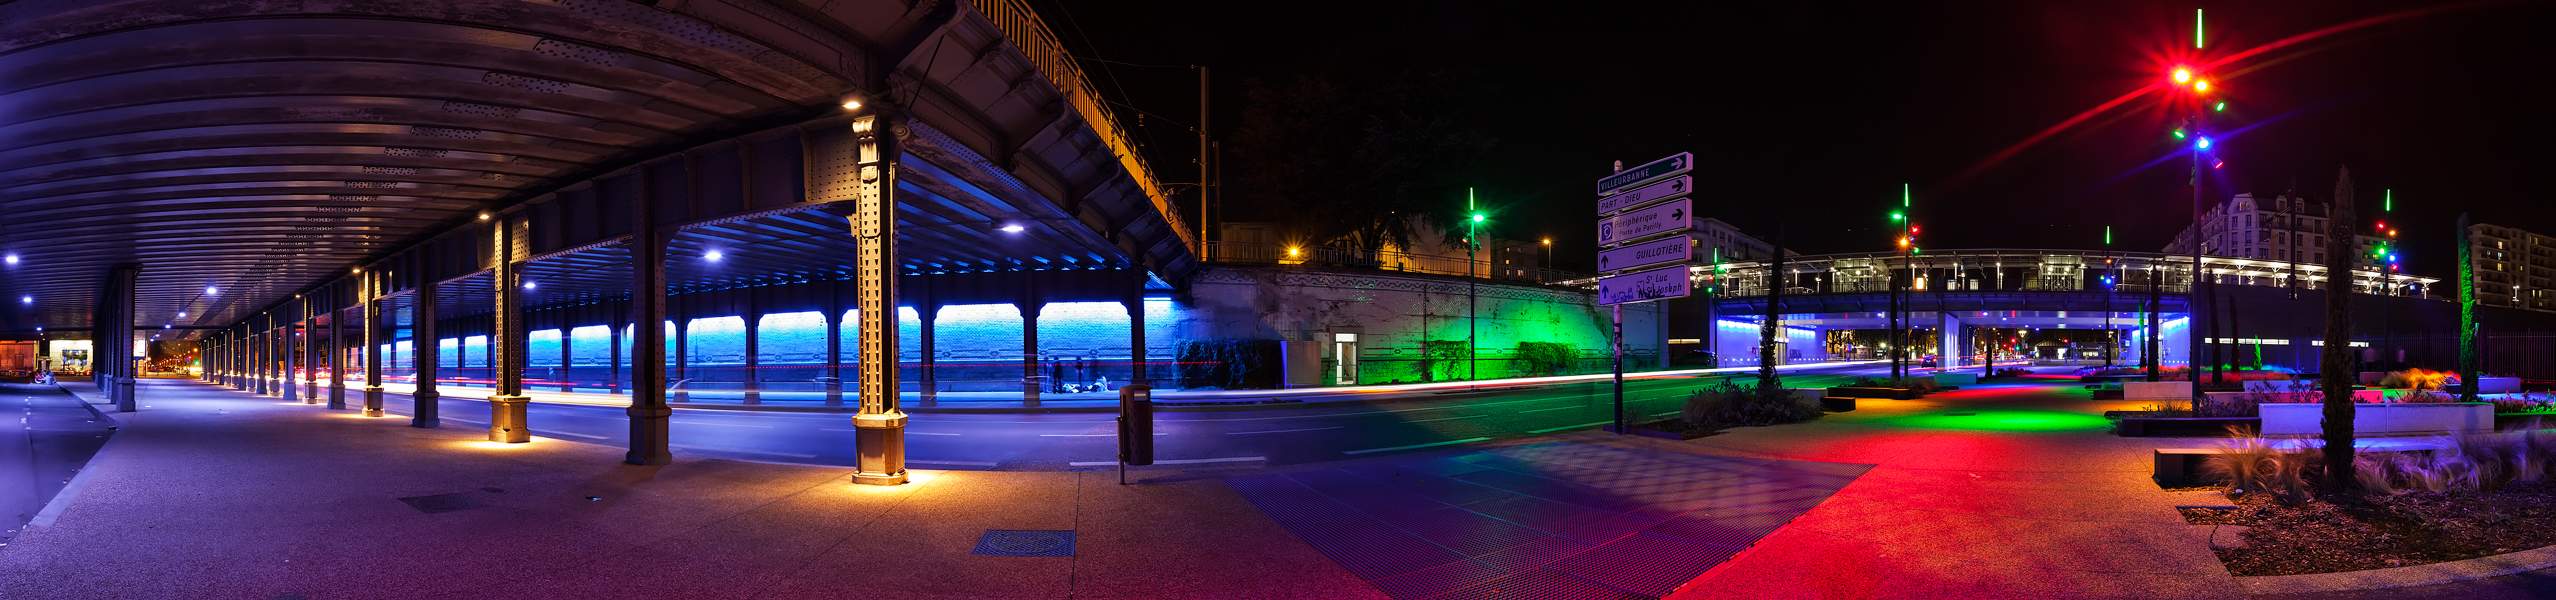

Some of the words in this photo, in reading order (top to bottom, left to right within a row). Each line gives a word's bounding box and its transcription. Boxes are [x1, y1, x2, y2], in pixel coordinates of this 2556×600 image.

[1600, 168, 1650, 190] VILLEURBANNE
[1601, 198, 1618, 210] PART
[1624, 192, 1641, 203] DIEU
[1636, 243, 1683, 259] GUILLOTIÈRE
[1655, 273, 1668, 283] Luc
